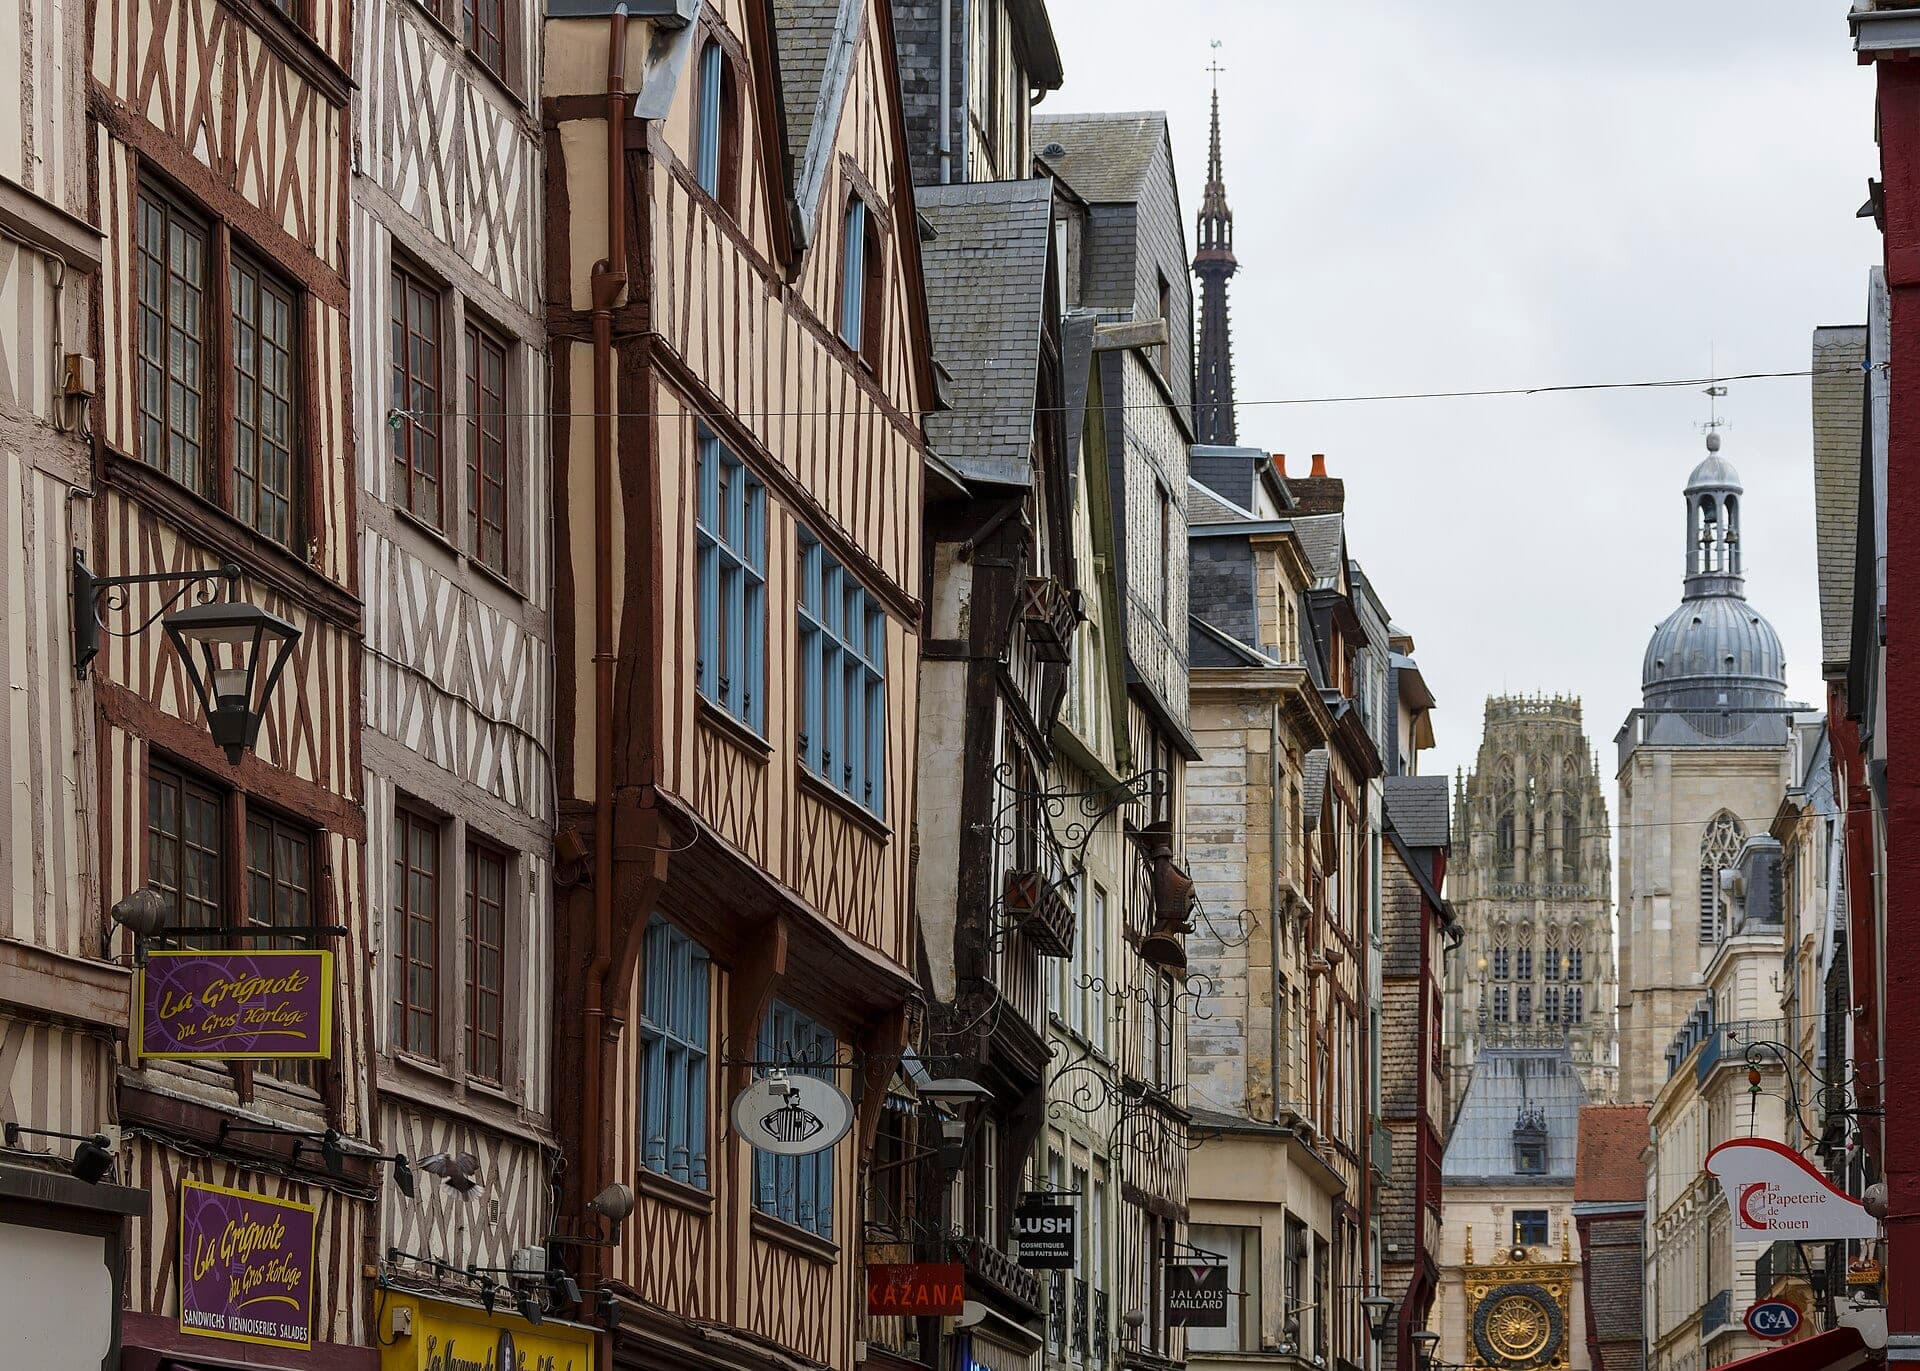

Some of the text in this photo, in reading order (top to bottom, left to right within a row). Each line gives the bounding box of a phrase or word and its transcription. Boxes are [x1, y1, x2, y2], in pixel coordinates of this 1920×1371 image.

[159, 969, 309, 1020] La Grignote
[177, 1001, 308, 1041] du Gros Horloge
[1767, 1182, 1780, 1192] La
[1767, 1192, 1826, 1207] Papeterie
[1767, 1207, 1779, 1216] de
[1015, 1217, 1072, 1233] LUSH
[1768, 1219, 1809, 1230] Rouen
[193, 1212, 286, 1281] La Grignote
[243, 1265, 265, 1294] Gros
[265, 1252, 302, 1291] Horloge
[868, 1284, 963, 1306] KAZANA
[1170, 1289, 1223, 1300] JALADIS
[1170, 1299, 1223, 1310] MAILLARD
[184, 1309, 307, 1342] SANDWICHS VIENNOISERIES SALADES
[1755, 1310, 1792, 1329] C&A
